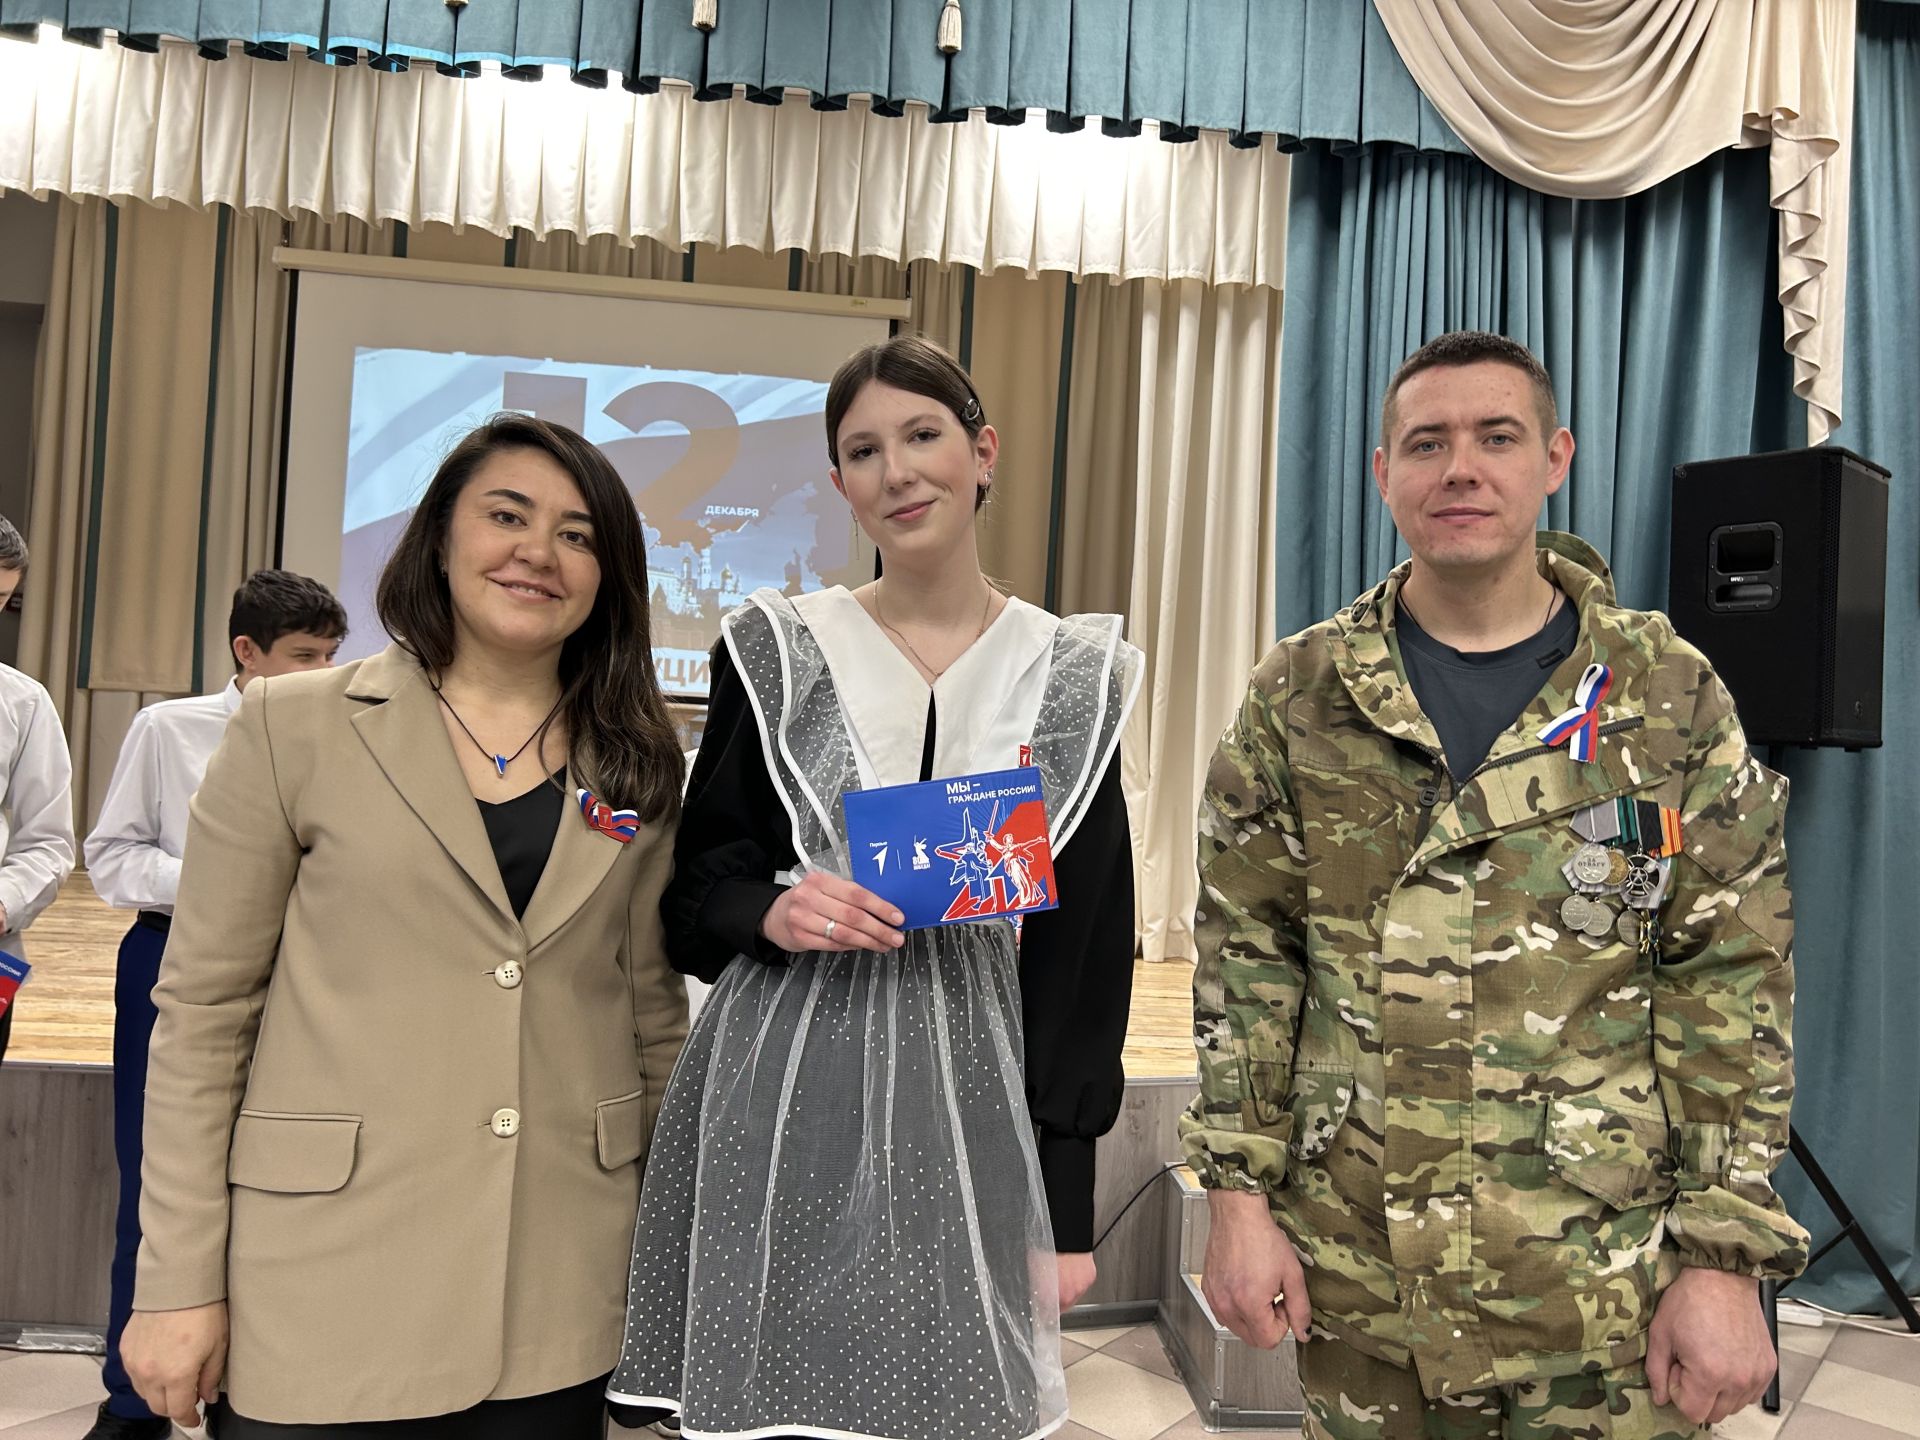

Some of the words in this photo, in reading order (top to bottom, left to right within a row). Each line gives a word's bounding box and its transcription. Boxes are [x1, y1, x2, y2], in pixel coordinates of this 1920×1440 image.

[705, 505, 759, 517] ДЕКАБРЯ
[946, 780, 971, 795] МЫ
[948, 790, 997, 804] ГРАЖДАНЕ
[997, 785, 1036, 797] РОССИИ!
